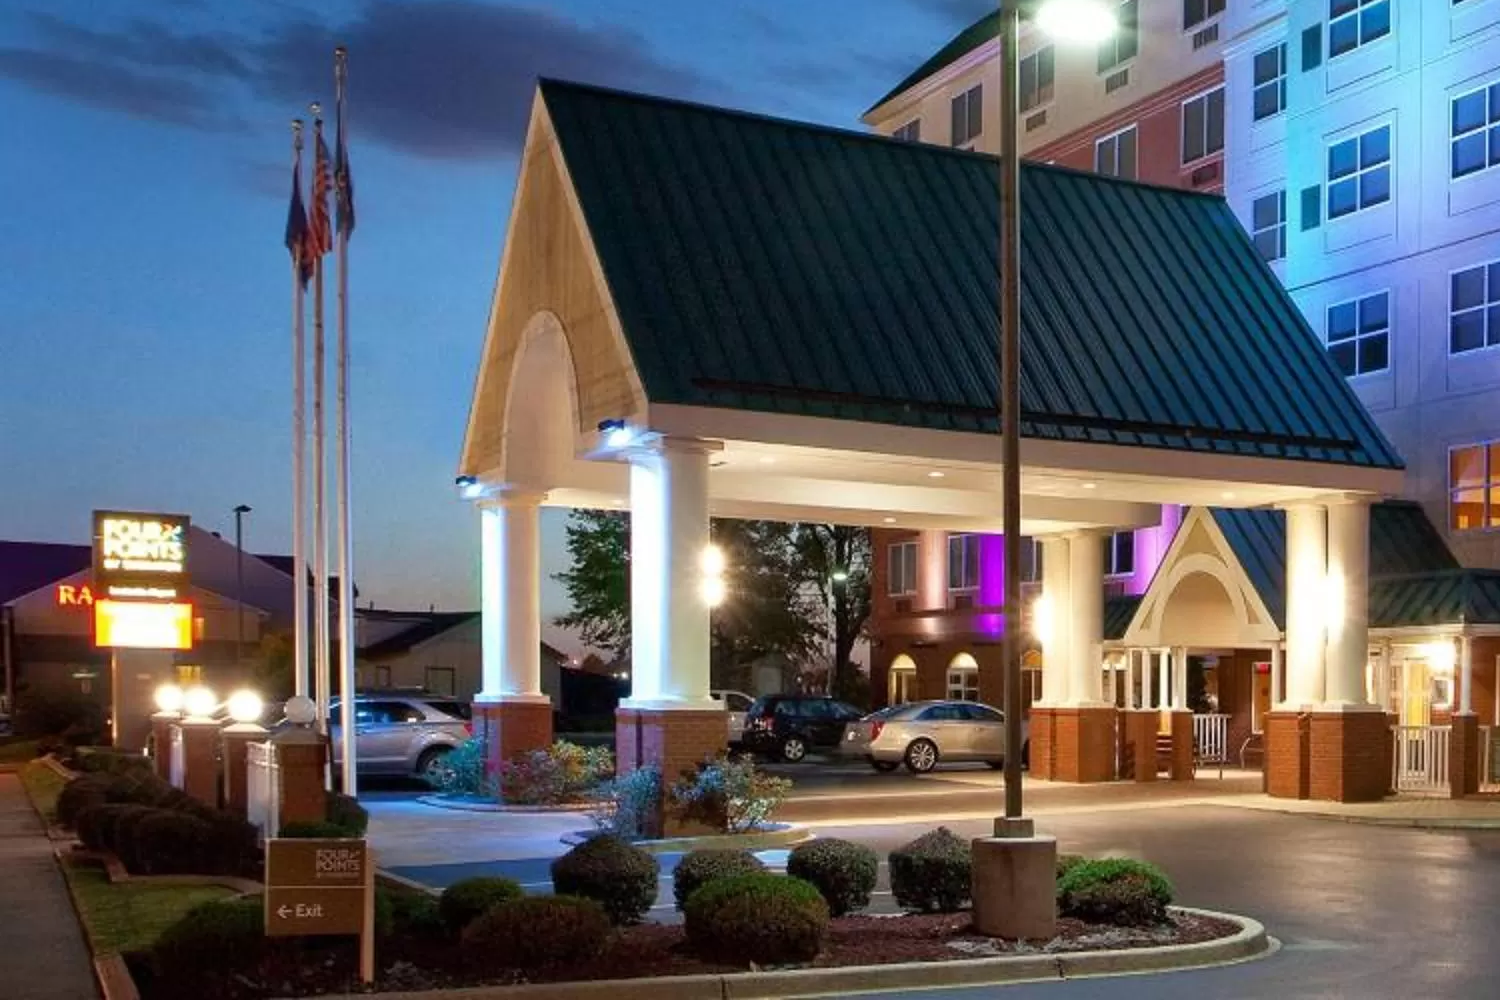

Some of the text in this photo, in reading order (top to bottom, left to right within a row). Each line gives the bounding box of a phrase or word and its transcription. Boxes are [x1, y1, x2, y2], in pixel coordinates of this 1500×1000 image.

[104, 519, 161, 540] FOUR
[104, 538, 183, 561] POINTS
[295, 903, 323, 917] Exit
